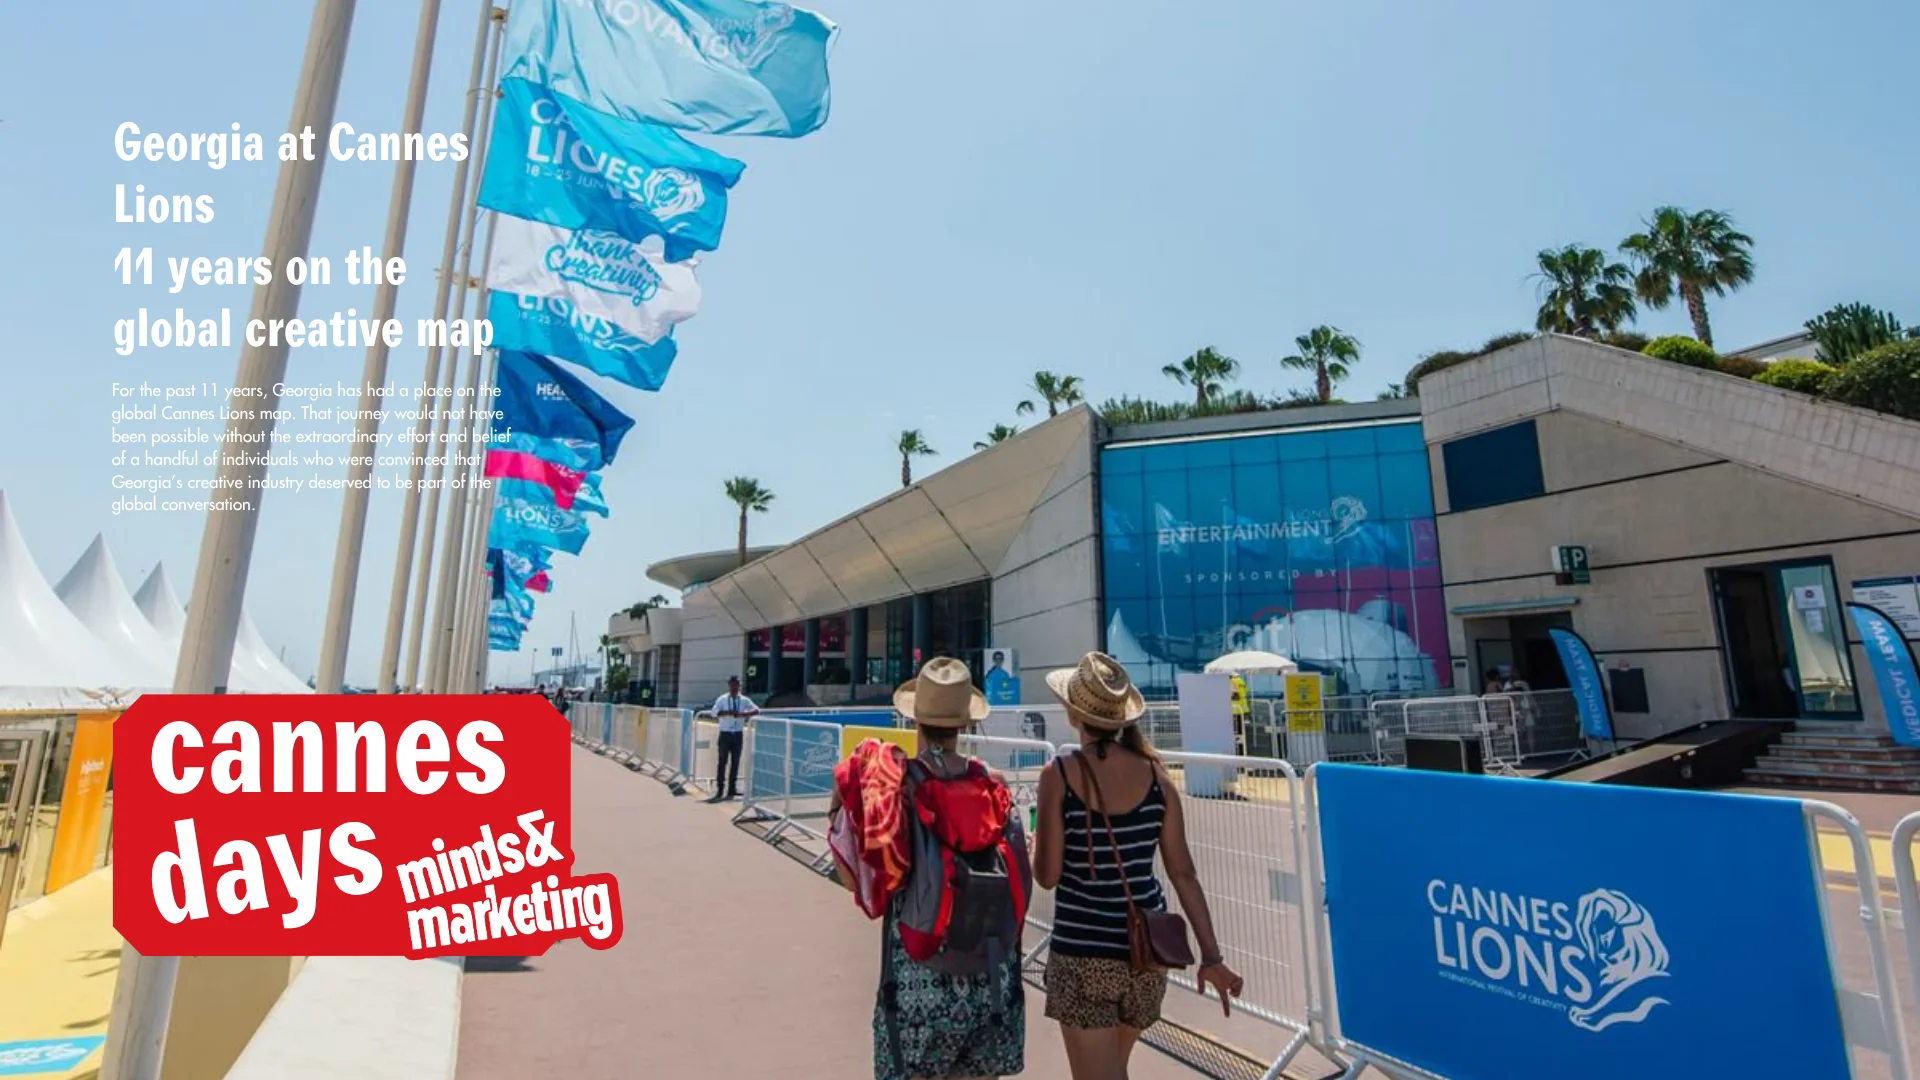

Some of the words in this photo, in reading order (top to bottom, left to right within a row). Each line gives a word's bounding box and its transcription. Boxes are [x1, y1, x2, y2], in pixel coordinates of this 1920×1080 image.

[1157, 519, 1331, 546] ENTERTAINMENT
[1571, 548, 1584, 568] P
[1185, 570, 1301, 583] SPONSORED
[1315, 568, 1338, 578] BY
[1427, 879, 1573, 941] CANNES
[1434, 916, 1593, 1003] LIONS
